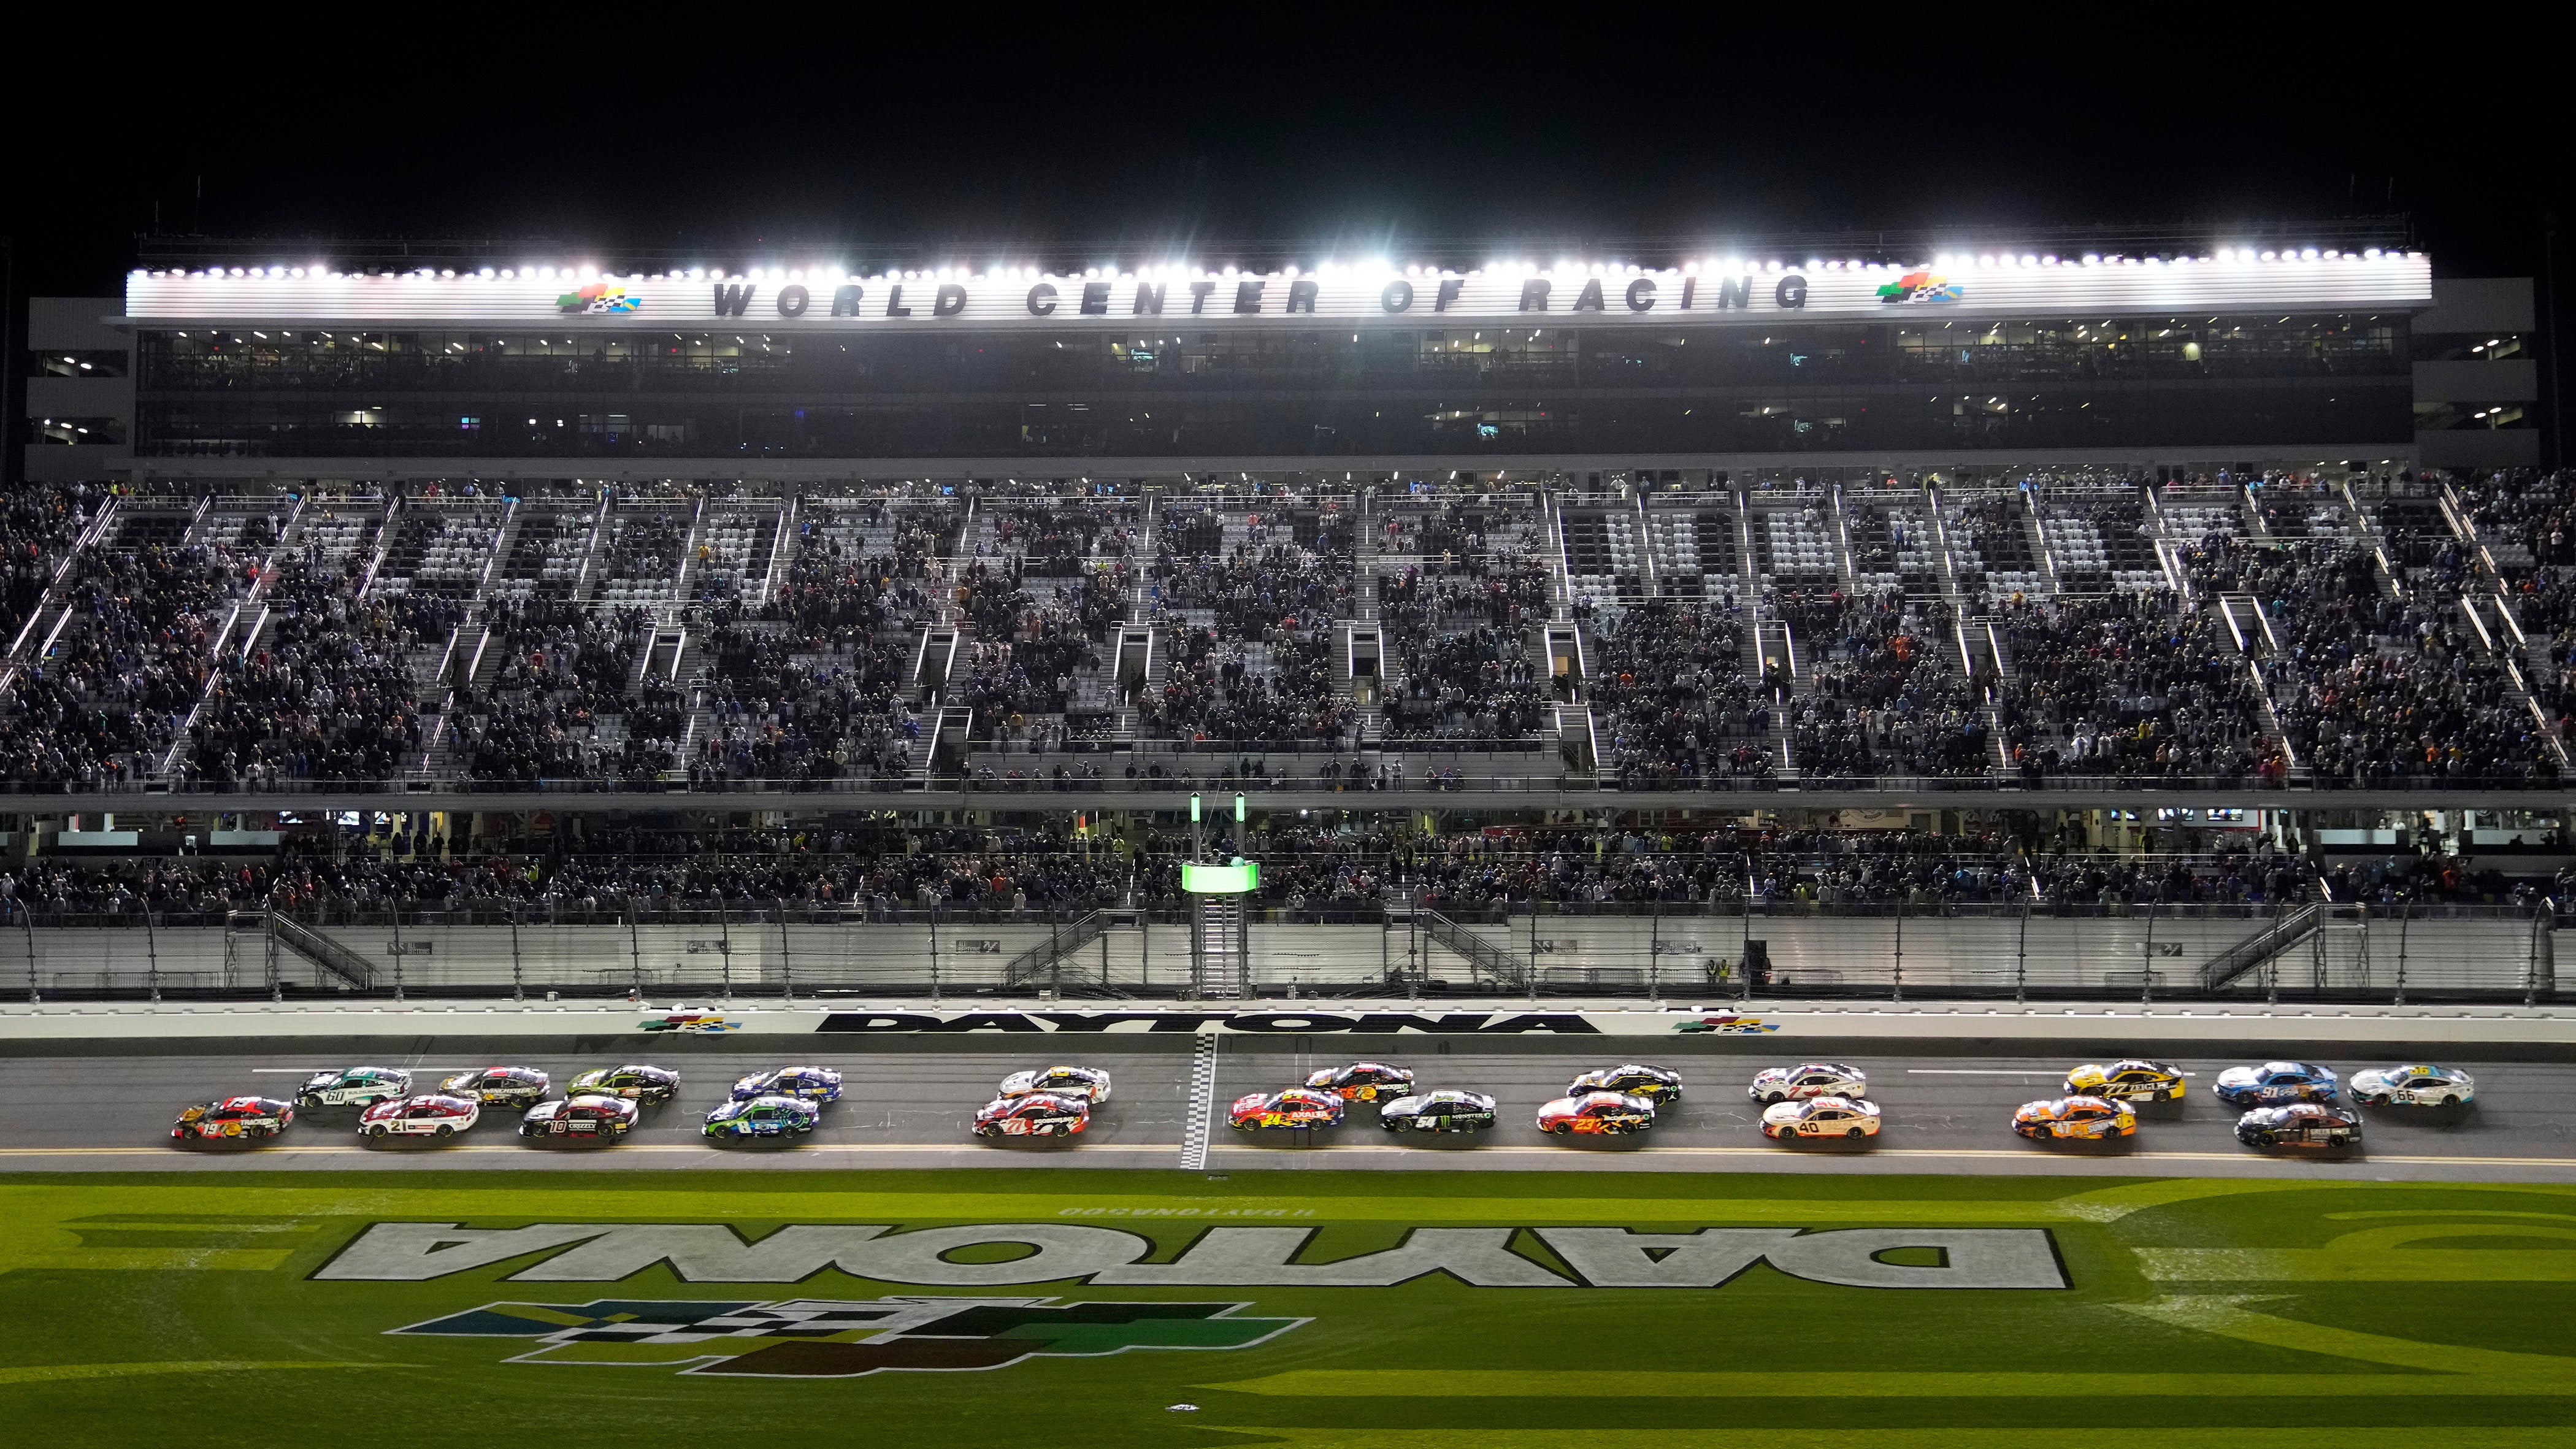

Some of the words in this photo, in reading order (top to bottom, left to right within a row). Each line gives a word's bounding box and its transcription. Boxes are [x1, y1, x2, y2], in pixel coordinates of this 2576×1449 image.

[714, 283, 967, 317] WORLD
[1027, 281, 1319, 316] CENTER
[1381, 279, 1465, 314] OF
[1519, 275, 1808, 312] RACING
[815, 1012, 1603, 1035] DAYTONA
[1788, 1086, 1801, 1099] 7
[2106, 1083, 2129, 1095] 77
[2261, 1086, 2279, 1098] 91
[326, 1091, 345, 1102] 60
[464, 1090, 482, 1102] 3
[2397, 1090, 2415, 1101] 66
[391, 1120, 407, 1131] 21
[1008, 1120, 1024, 1132] 71
[1265, 1114, 1282, 1126] 24
[1415, 1116, 1437, 1128] 54
[1574, 1119, 1595, 1130] 23
[203, 1123, 219, 1135] 19
[550, 1120, 567, 1133] 10
[737, 1121, 753, 1134] 8
[1800, 1123, 1819, 1133] 40
[2056, 1123, 2071, 1134] 47
[310, 1221, 2076, 1292] DAYTONA
